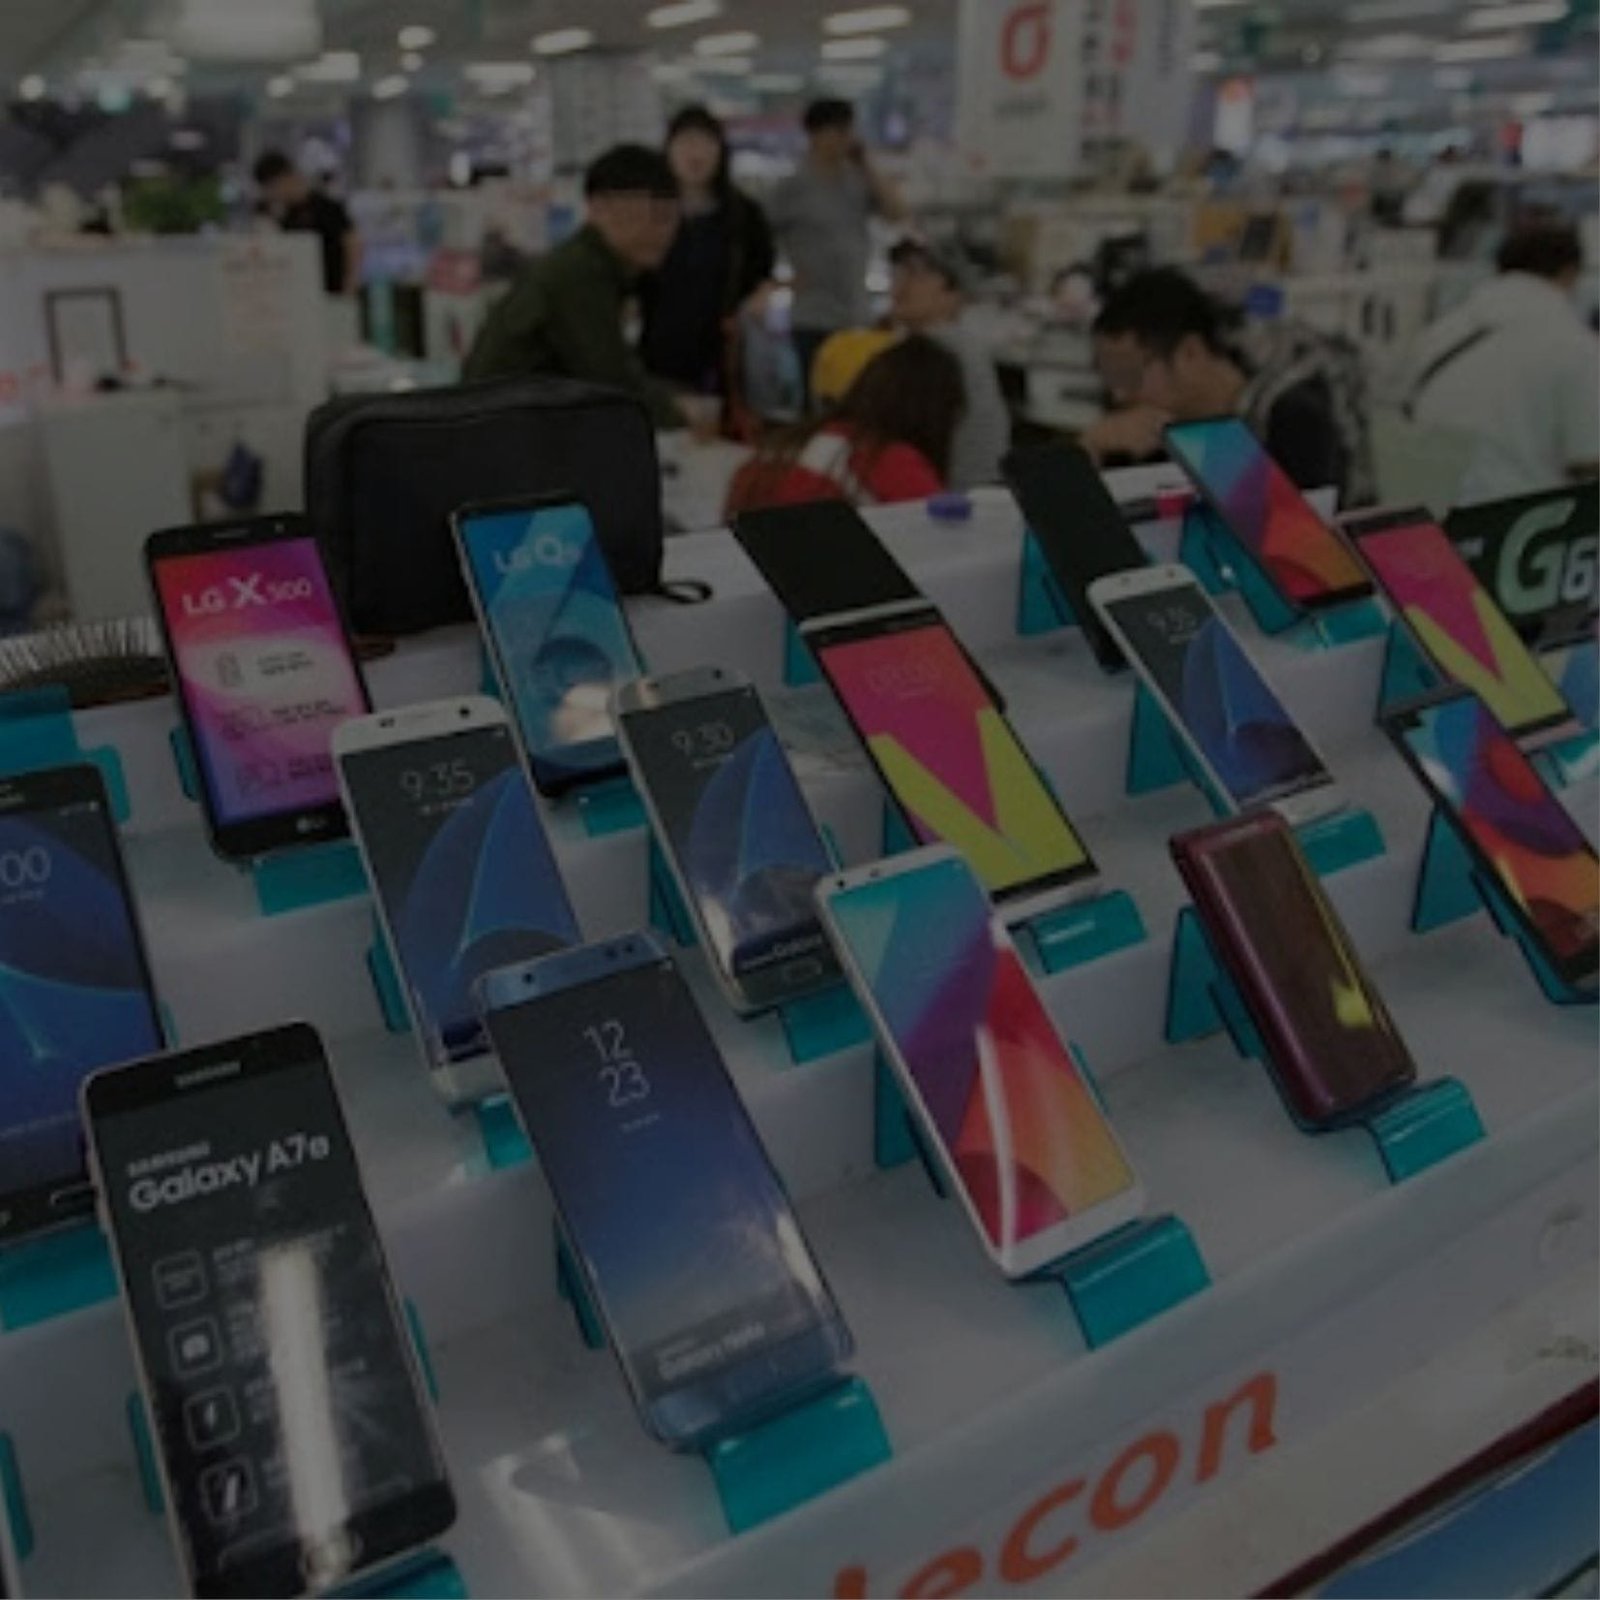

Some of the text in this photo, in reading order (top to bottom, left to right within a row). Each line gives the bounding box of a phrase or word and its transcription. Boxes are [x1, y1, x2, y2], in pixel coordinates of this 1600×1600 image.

[181, 585, 227, 616] LG
[581, 1019, 634, 1062] 12
[598, 1060, 652, 1107] 23
[127, 1149, 264, 1214] Galaxy
[832, 1370, 1278, 1600] econ
